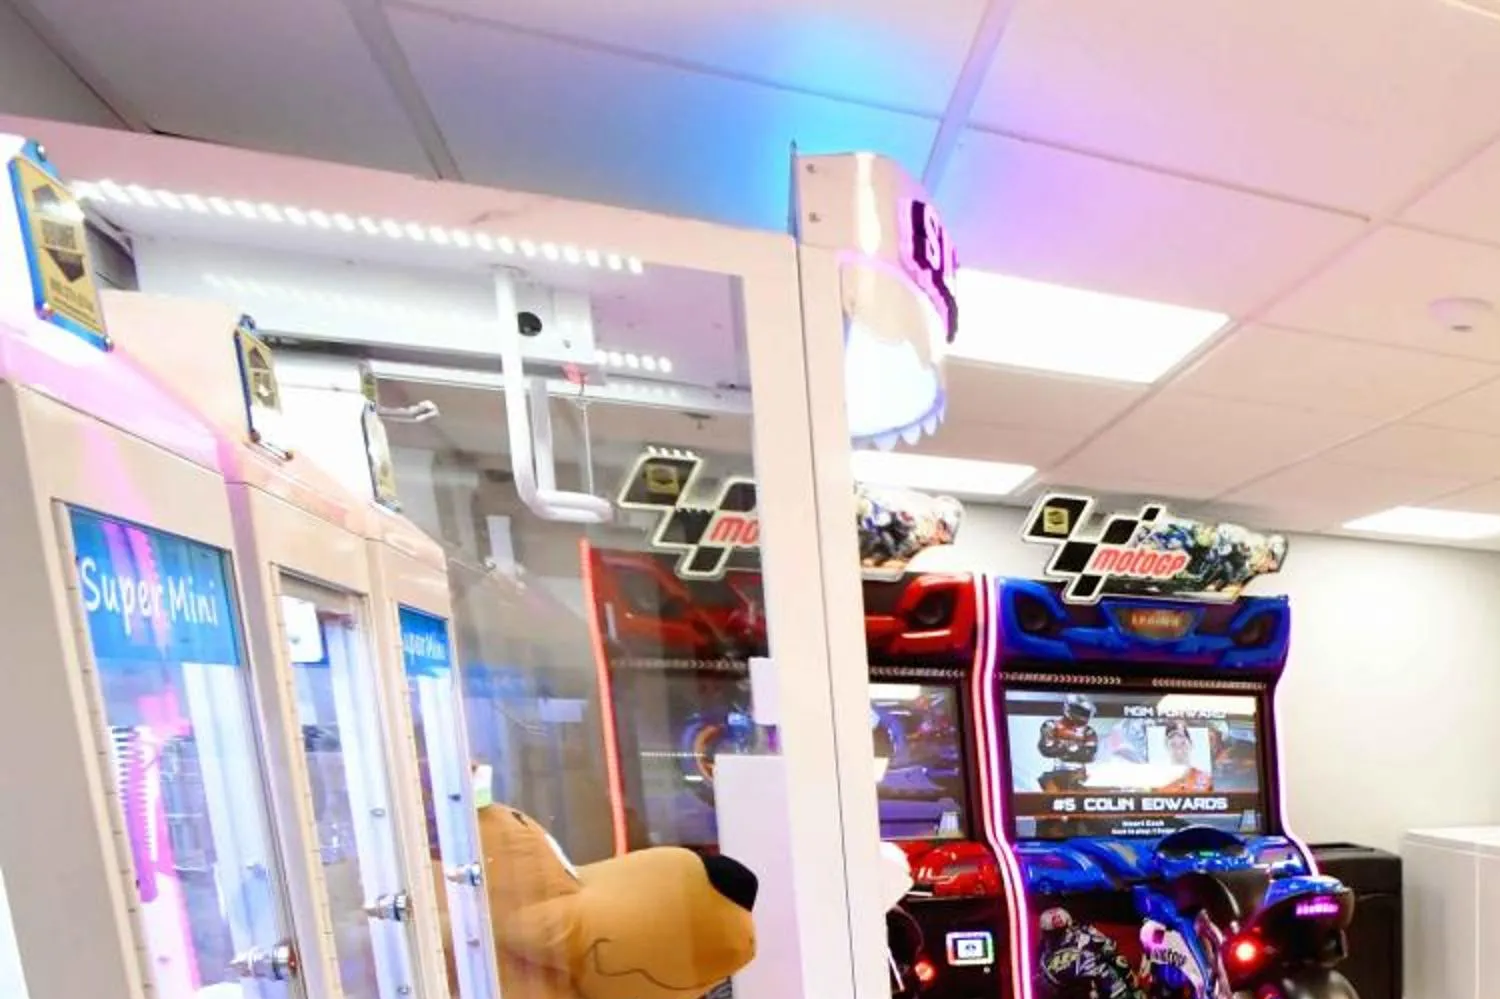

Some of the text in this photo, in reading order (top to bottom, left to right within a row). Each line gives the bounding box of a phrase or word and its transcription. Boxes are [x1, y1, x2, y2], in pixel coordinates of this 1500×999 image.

[81, 556, 218, 637] Super Mini
[1084, 797, 1135, 811] COLIN
[1142, 797, 1228, 811] EDWARDS
